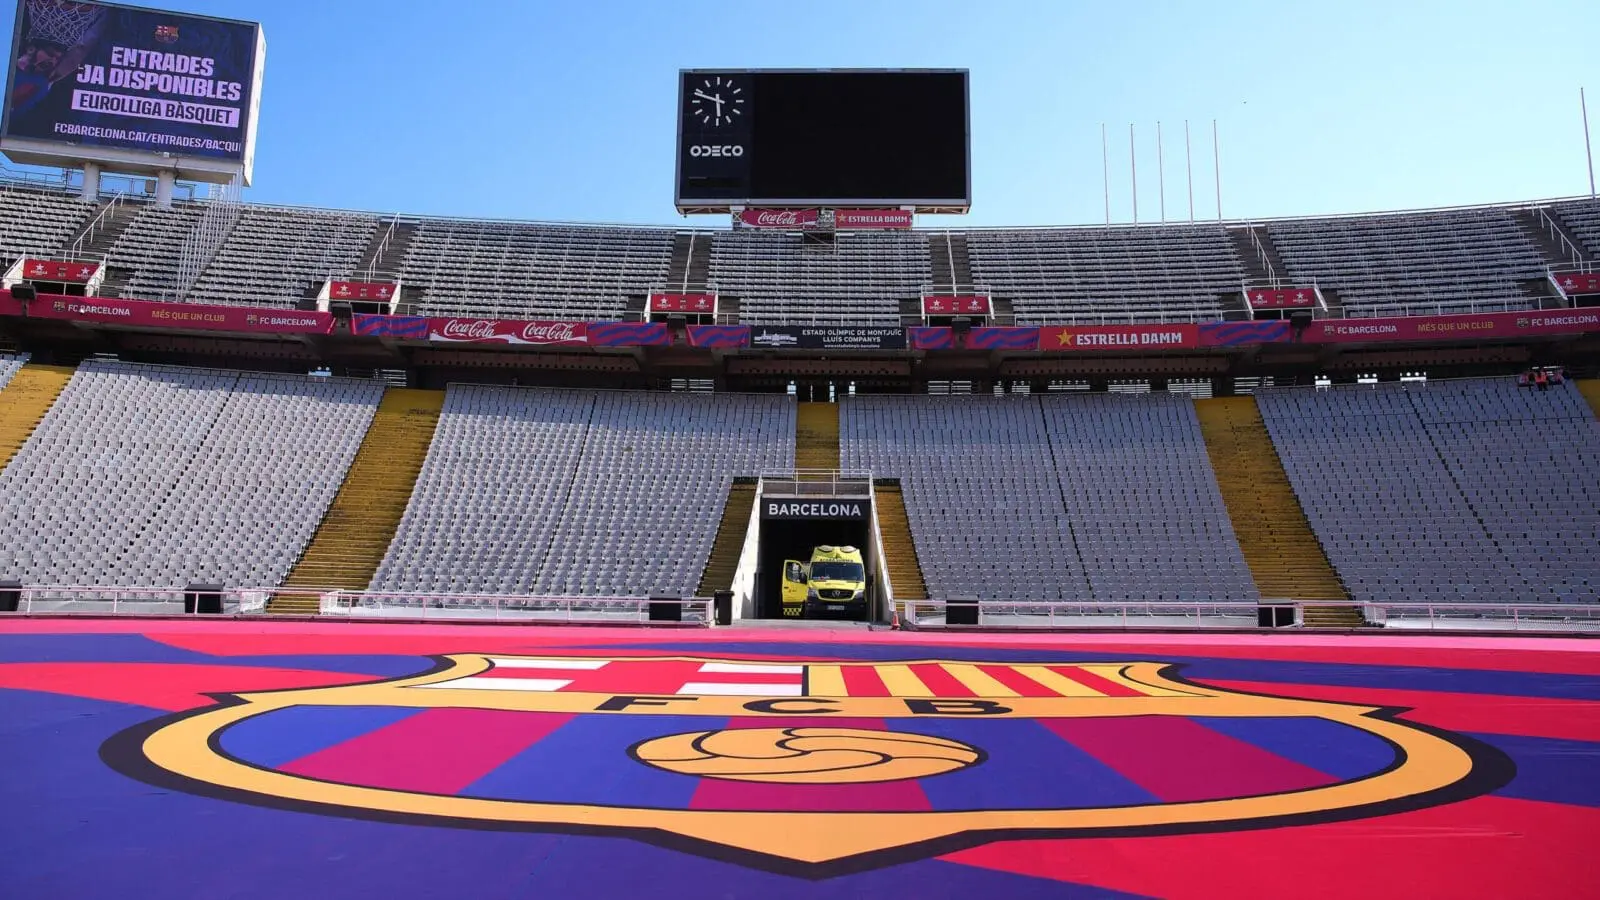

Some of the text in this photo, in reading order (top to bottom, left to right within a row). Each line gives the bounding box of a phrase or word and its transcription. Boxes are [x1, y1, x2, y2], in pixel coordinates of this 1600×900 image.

[111, 46, 214, 77] ENTRADES
[77, 64, 241, 101] JA DISPONIBLES
[80, 93, 232, 124] EUROLLIGA BÀSQUET
[54, 122, 241, 152] FCBARCELONA.CAT/ENTRADES/BASQU
[690, 145, 743, 157] ODECO
[68, 304, 78, 312] FC
[80, 305, 130, 316] BARCELONA
[152, 310, 170, 319] MÉS
[172, 312, 189, 320] QUE
[260, 317, 270, 325] FC
[271, 318, 317, 326] BARCELONA
[1349, 325, 1397, 334] BARCELONA
[1417, 323, 1435, 332] MÉS
[1471, 321, 1494, 329] CLUB
[1531, 318, 1542, 326] FC
[1544, 315, 1598, 326] BARCELONA
[1076, 332, 1183, 346] ESTRELLA DAMM
[768, 503, 862, 516] BARCELONA
